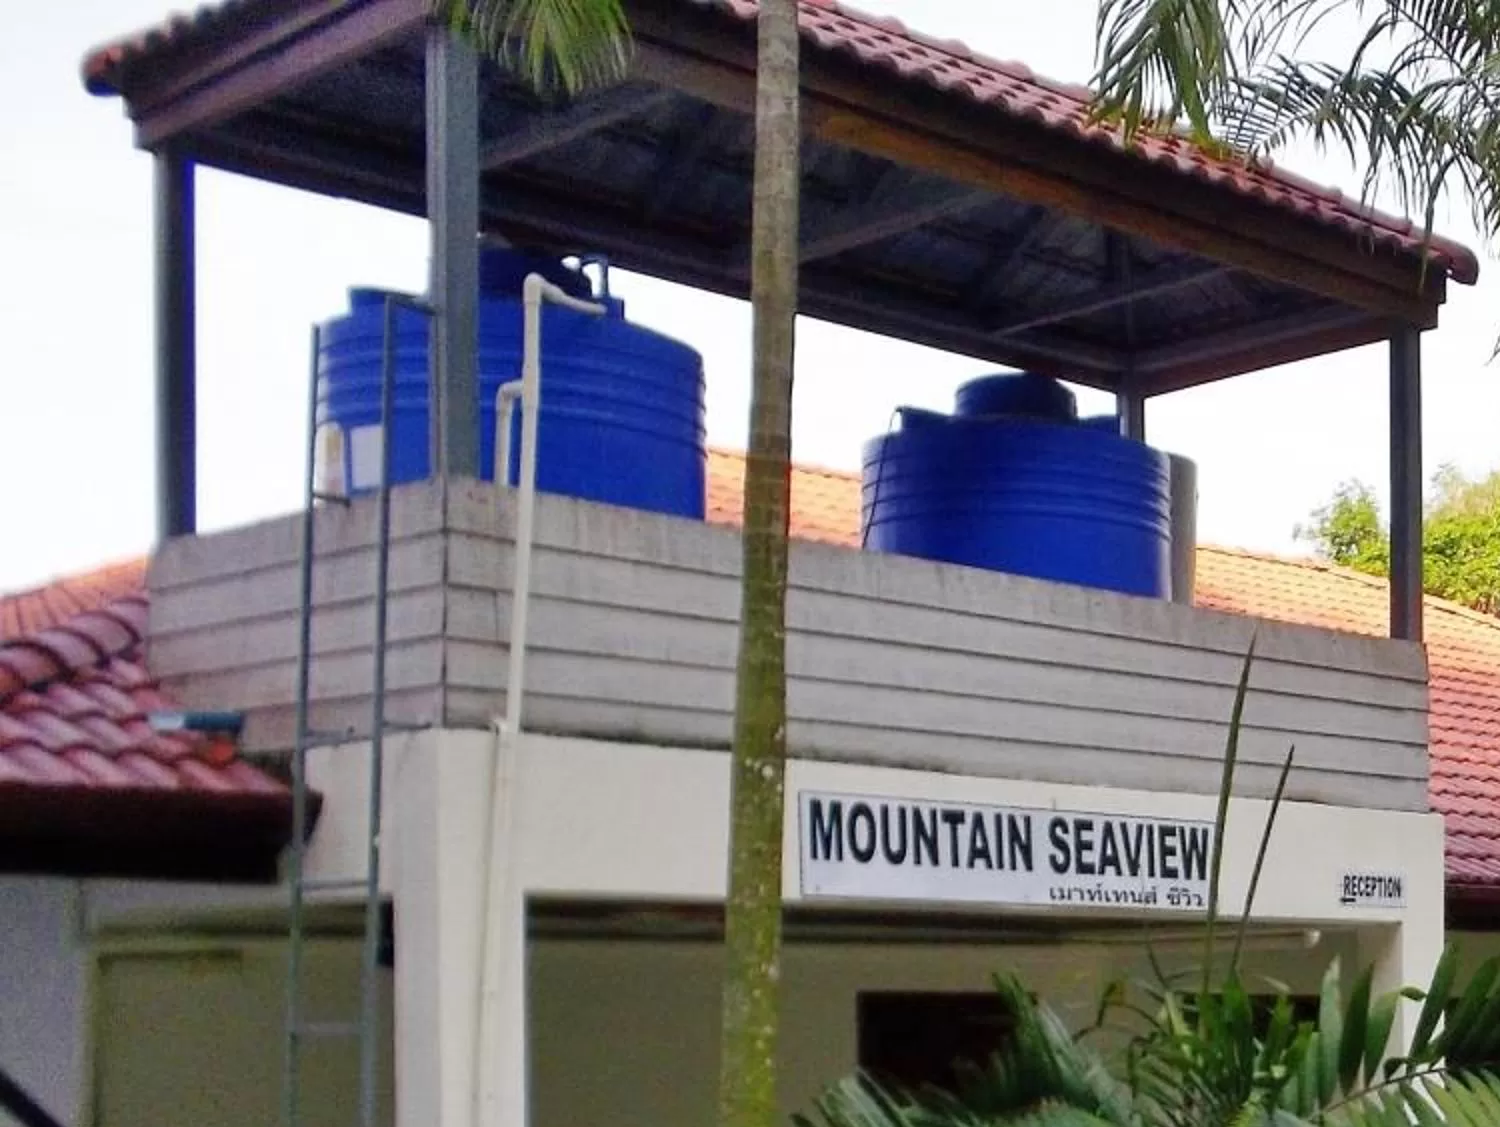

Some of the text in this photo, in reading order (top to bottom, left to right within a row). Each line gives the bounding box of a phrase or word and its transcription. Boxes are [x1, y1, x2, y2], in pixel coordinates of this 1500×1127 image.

[810, 799, 1208, 882] MOUNTAIN SEAVIEW
[1343, 875, 1402, 898] RECEPTION
